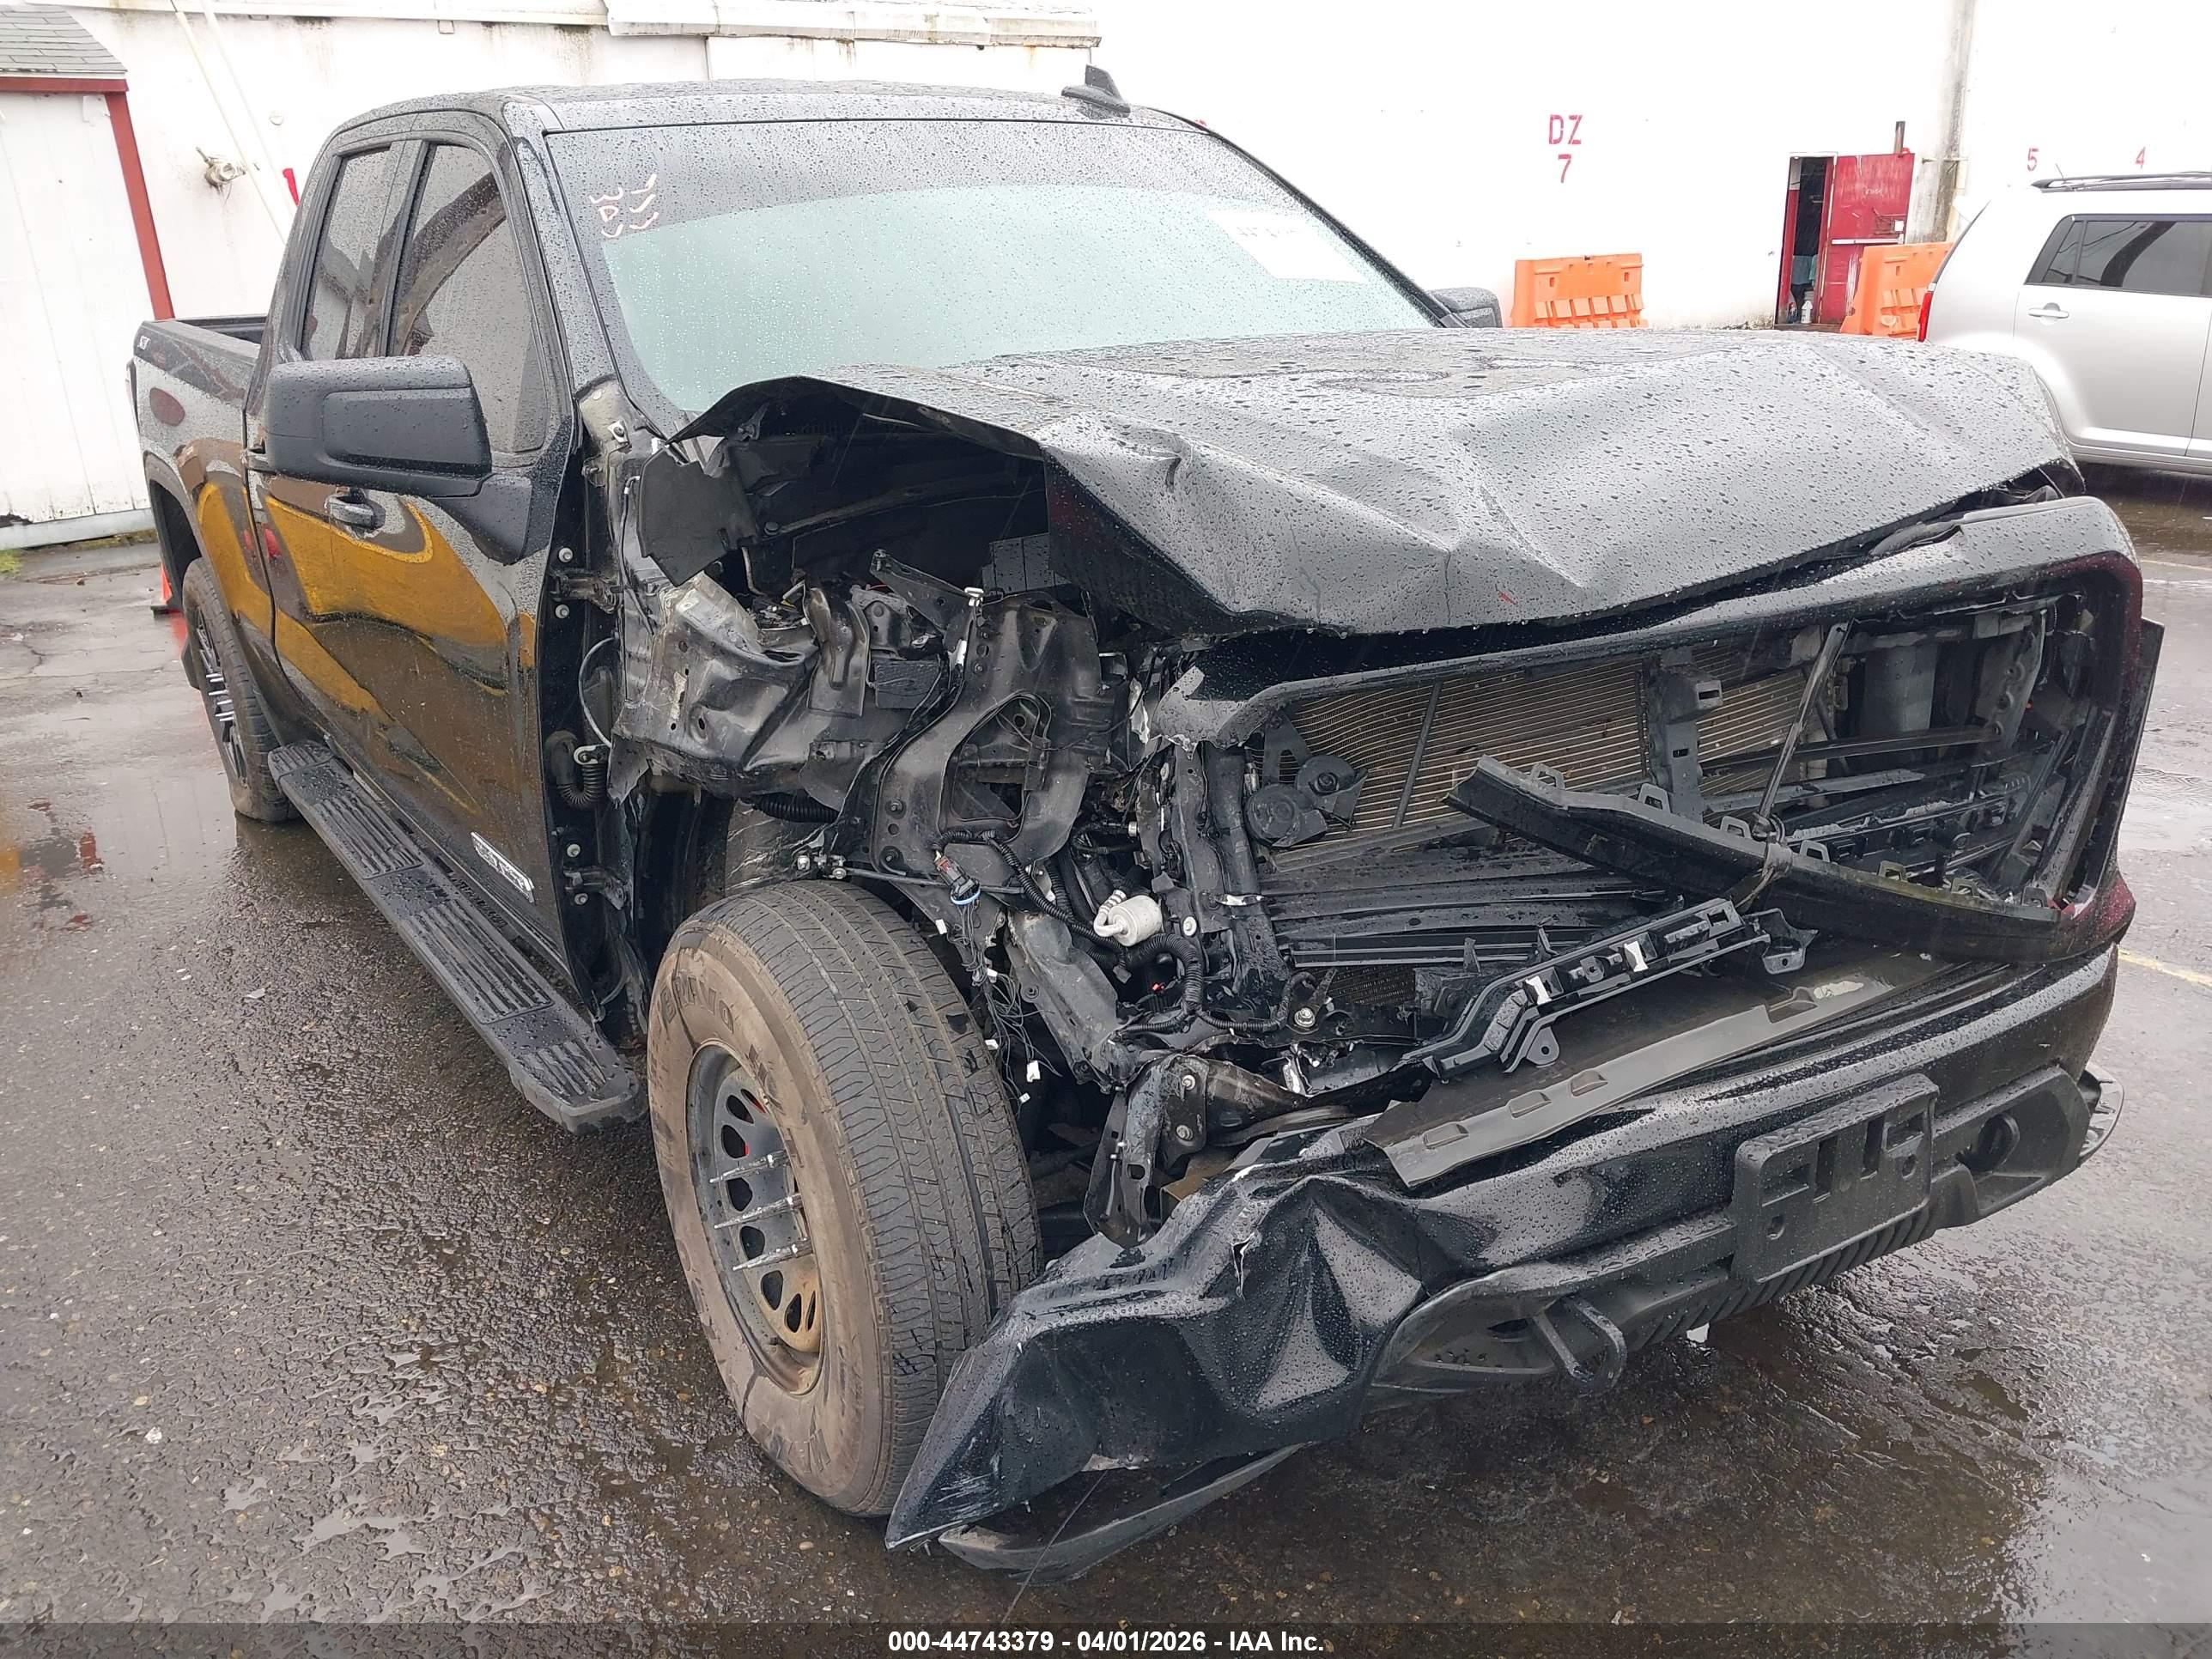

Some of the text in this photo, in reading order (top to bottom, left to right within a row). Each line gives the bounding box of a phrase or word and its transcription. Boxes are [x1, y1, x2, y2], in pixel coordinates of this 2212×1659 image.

[1548, 114, 1583, 144] DZ
[1558, 154, 1571, 184] 7
[2027, 148, 2039, 172] 5
[2135, 146, 2146, 169] 4
